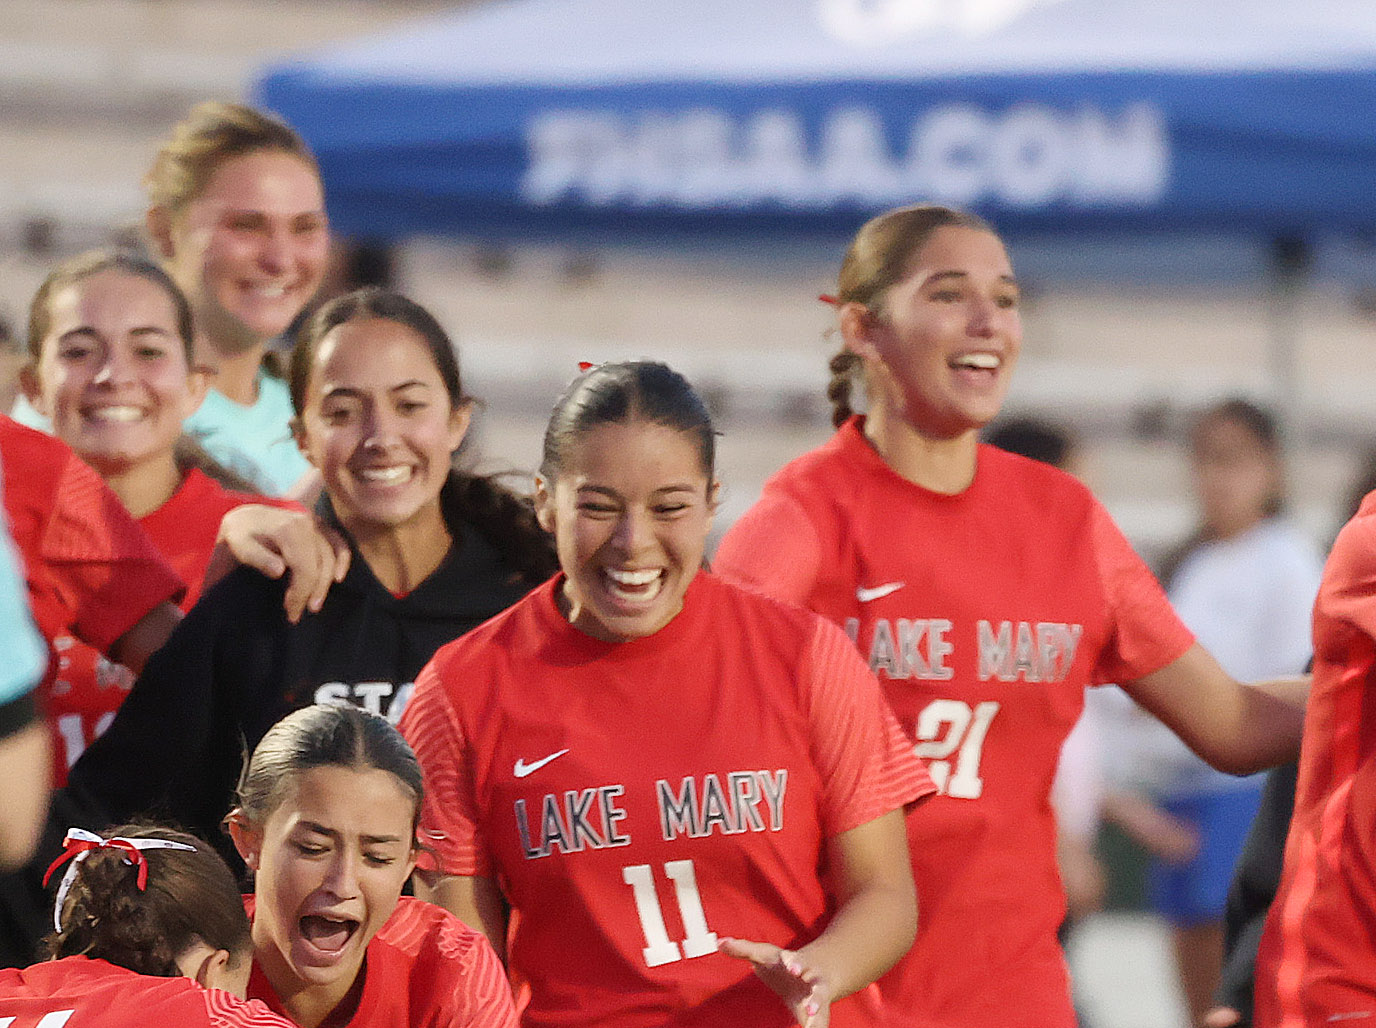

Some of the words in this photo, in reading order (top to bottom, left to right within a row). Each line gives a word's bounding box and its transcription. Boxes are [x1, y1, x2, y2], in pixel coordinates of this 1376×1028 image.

[977, 619, 1083, 682] MARY
[914, 699, 1000, 799] 21
[514, 785, 631, 859] LAKE
[656, 769, 789, 841] MARY
[623, 859, 719, 968] 11
